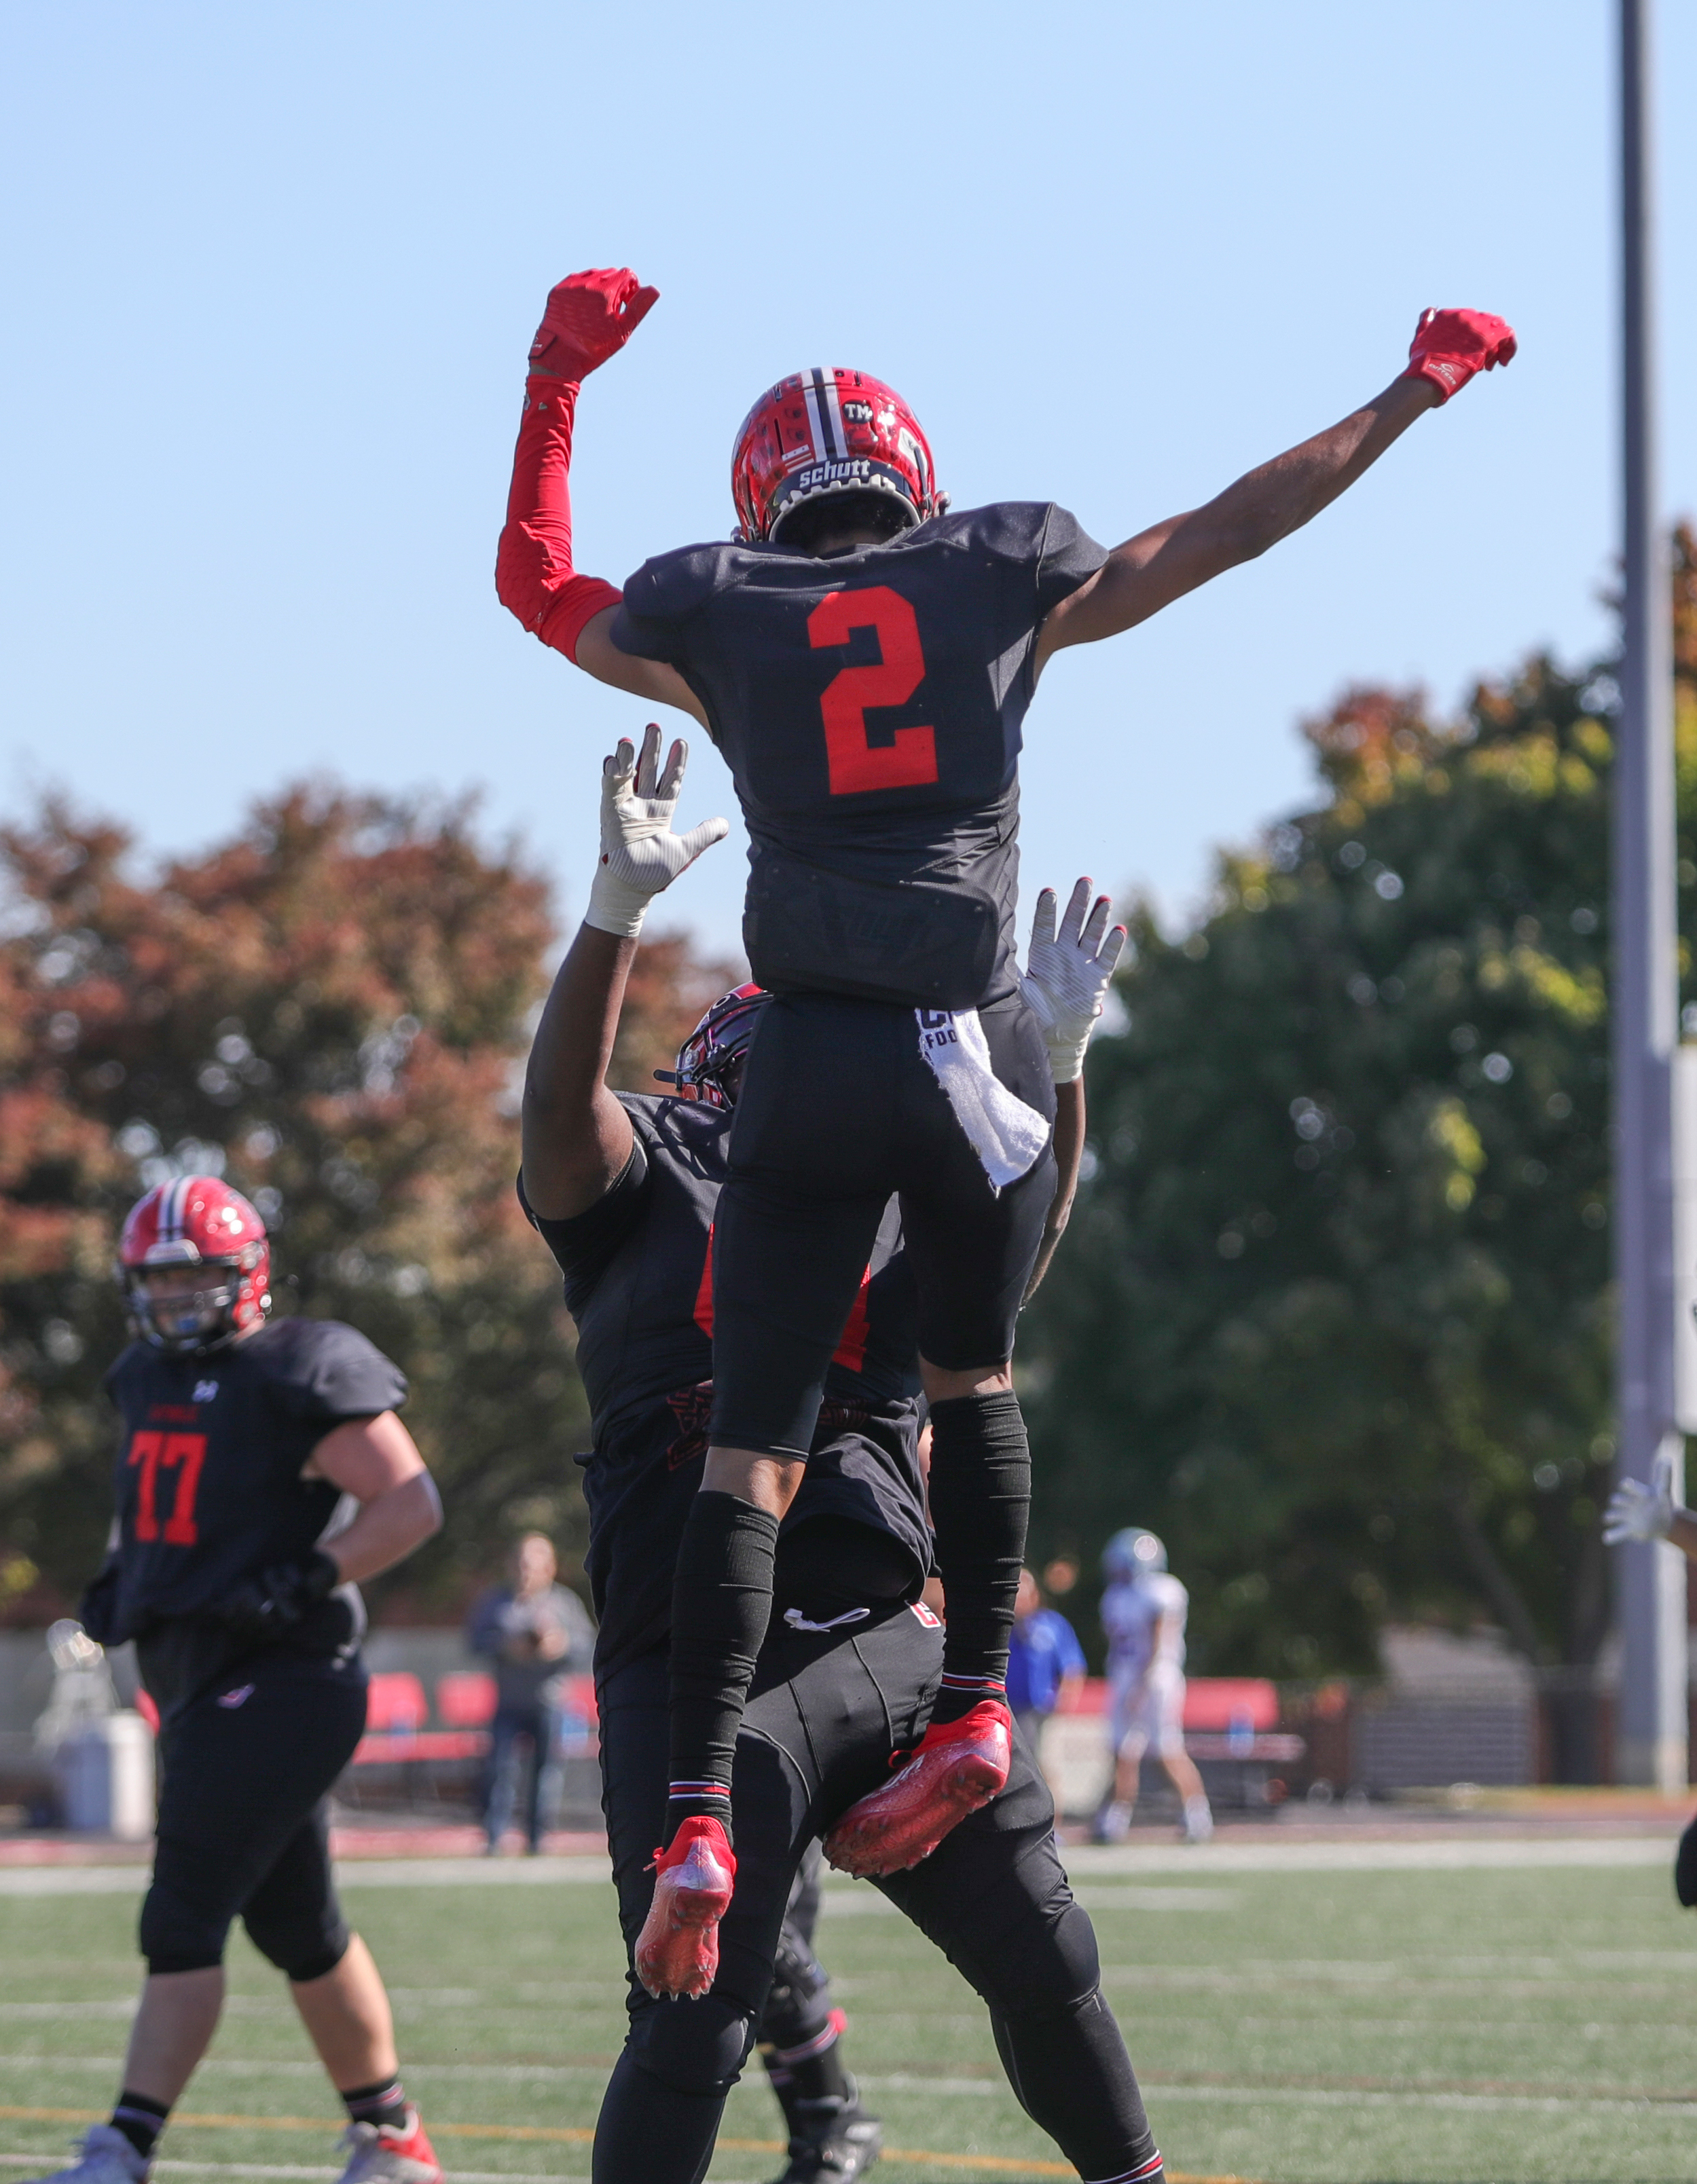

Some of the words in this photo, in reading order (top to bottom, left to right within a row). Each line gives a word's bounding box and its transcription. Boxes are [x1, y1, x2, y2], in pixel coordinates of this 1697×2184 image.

[845, 403, 871, 420] TM
[799, 460, 870, 488] schutt
[807, 585, 939, 795] 2
[127, 1430, 207, 1547] 77
